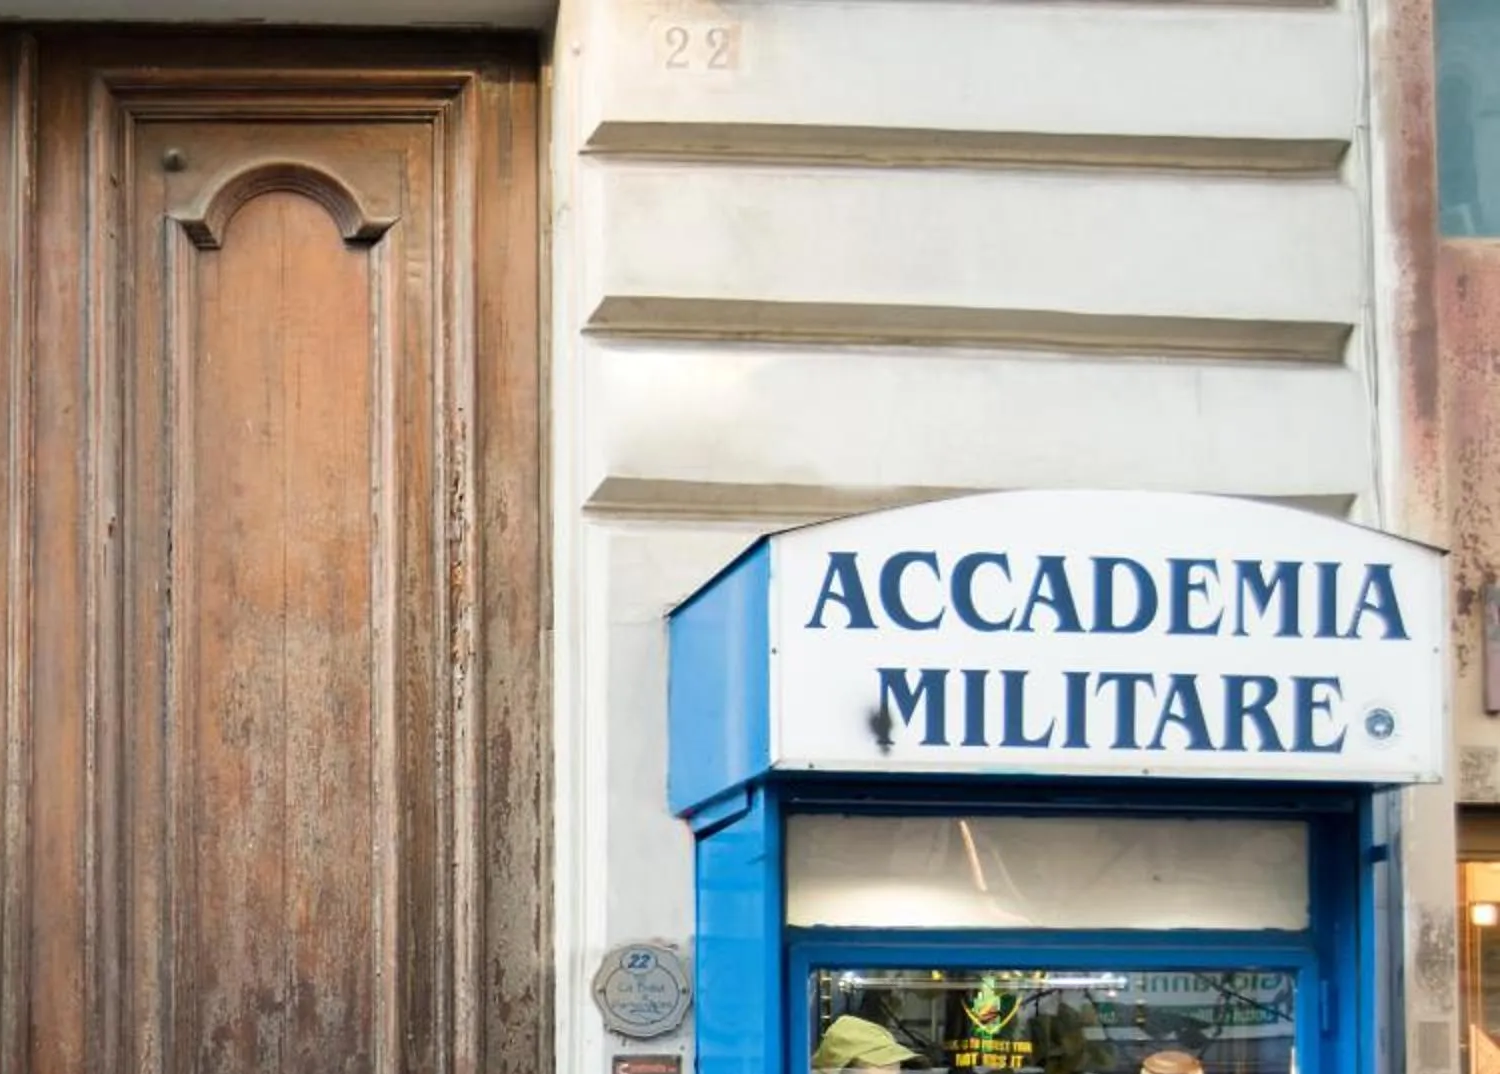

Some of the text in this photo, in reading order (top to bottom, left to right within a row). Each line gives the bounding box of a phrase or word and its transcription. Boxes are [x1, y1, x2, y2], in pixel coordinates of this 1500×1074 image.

[665, 26, 732, 70] 22
[805, 550, 1412, 642] ACCADEMIA
[876, 667, 1348, 755] MILITARE
[628, 954, 651, 969] 22
